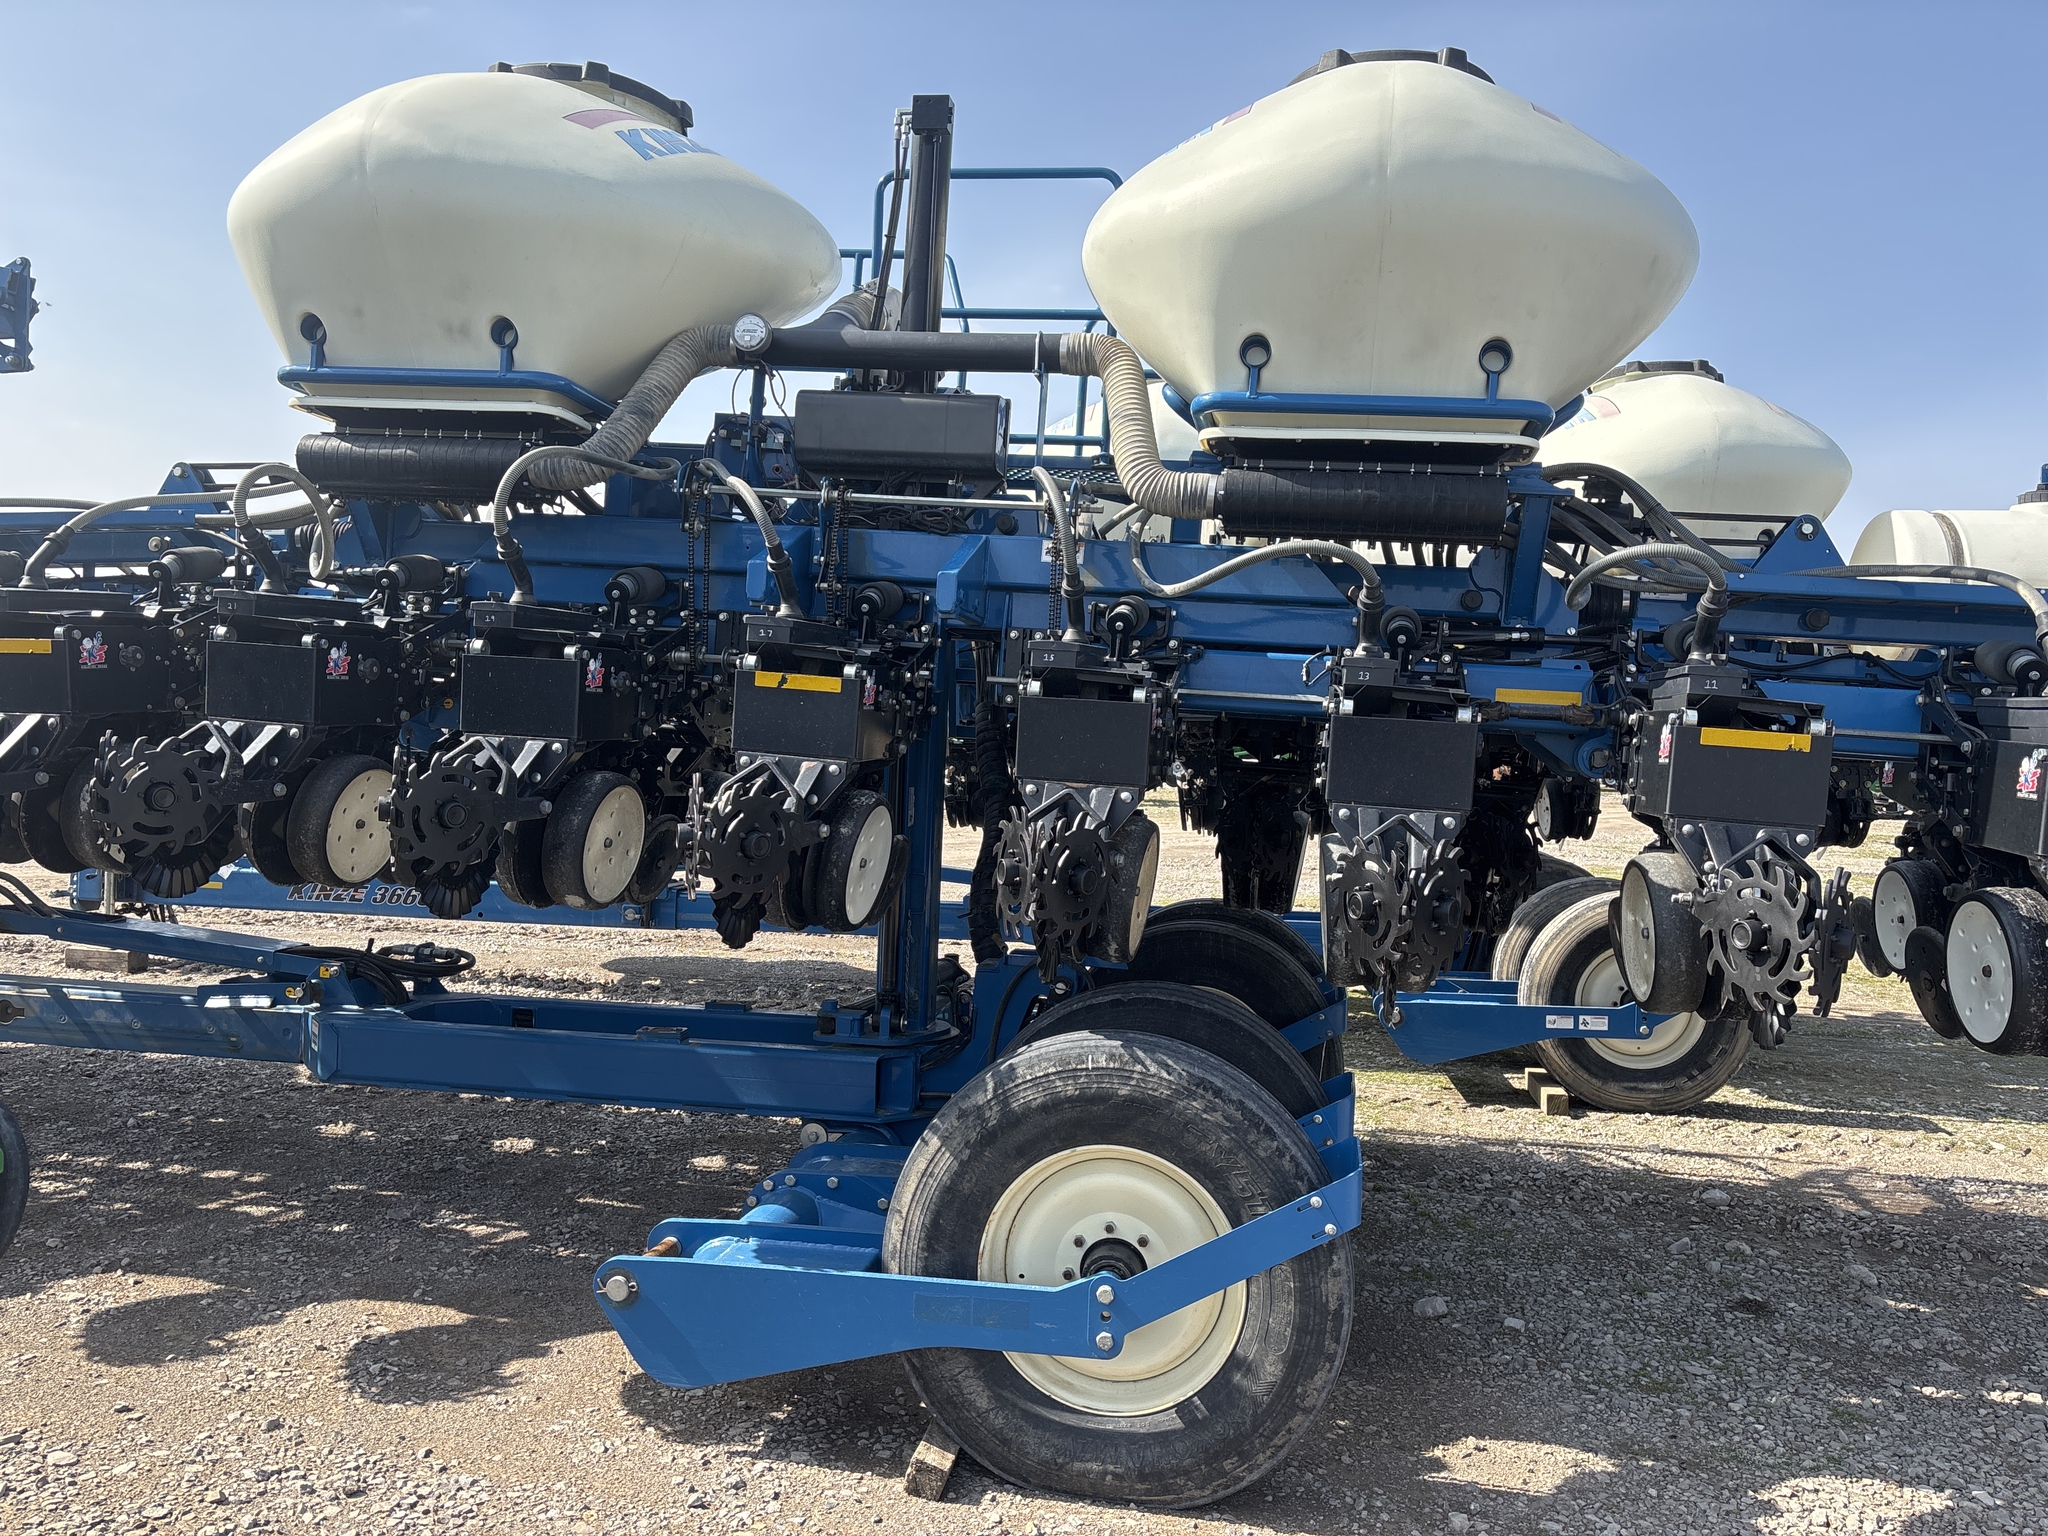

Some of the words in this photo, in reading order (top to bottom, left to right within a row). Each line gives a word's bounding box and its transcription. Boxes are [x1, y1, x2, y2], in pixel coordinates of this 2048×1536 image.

[759, 629, 773, 637] 17
[1043, 653, 1055, 661] 15
[1358, 671, 1370, 680] 13
[1704, 679, 1718, 689] 11
[287, 882, 370, 904] KINZE
